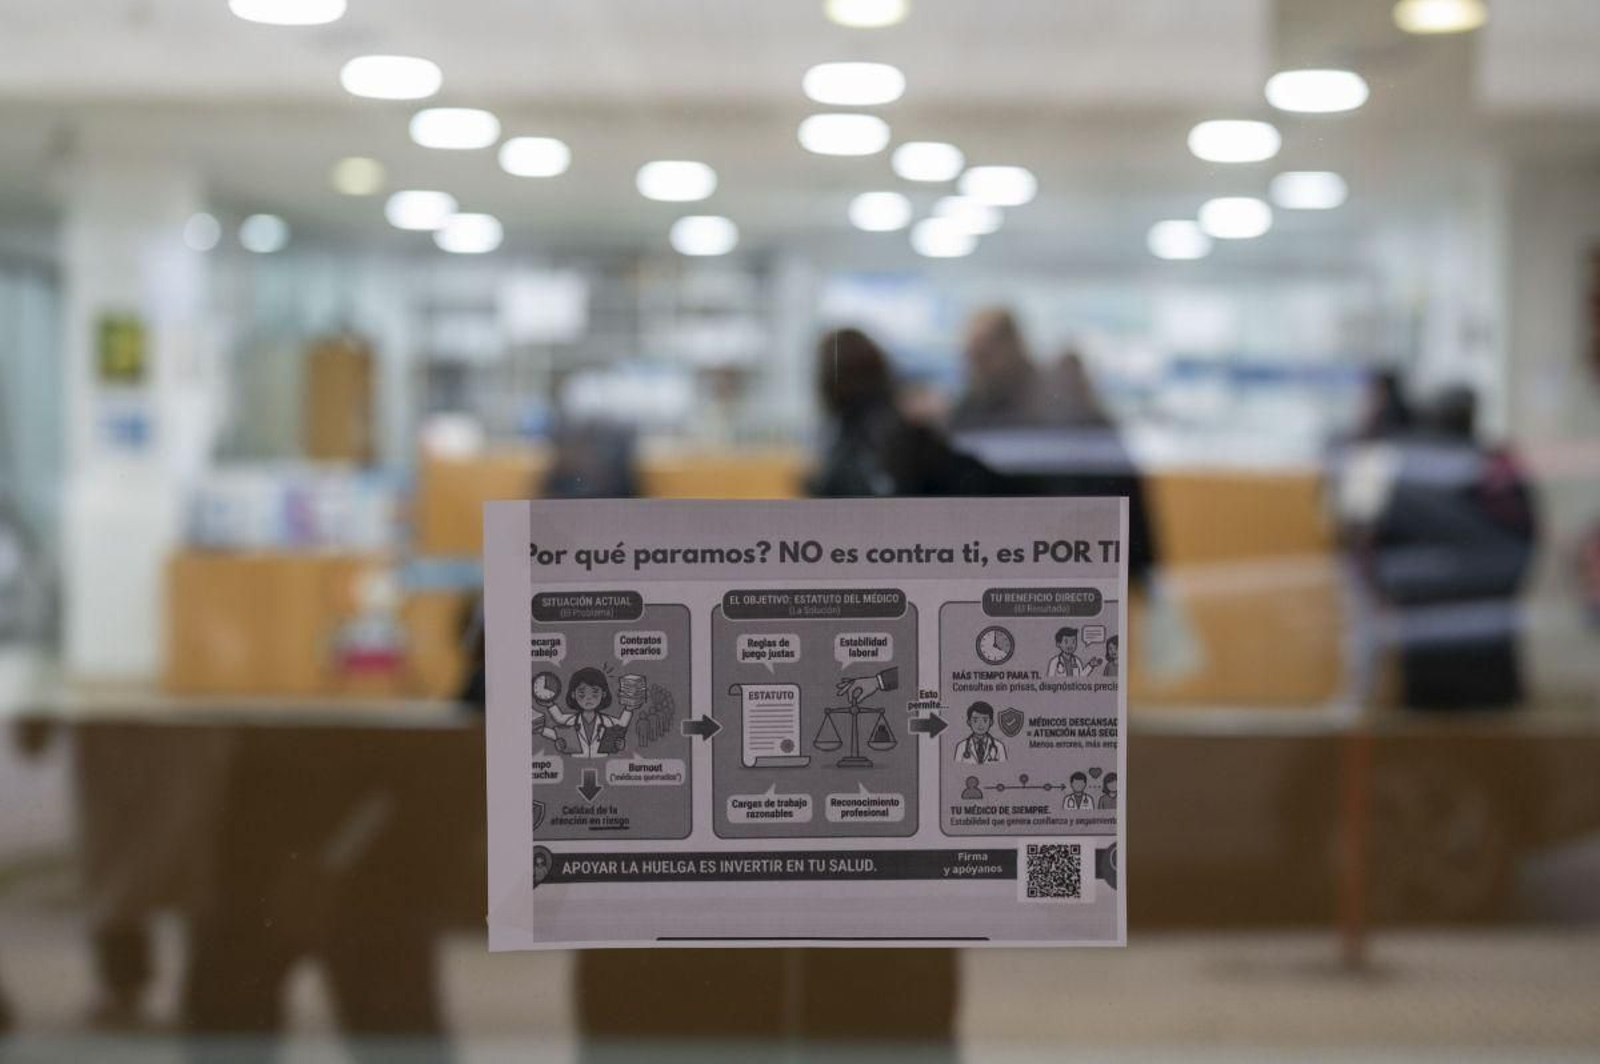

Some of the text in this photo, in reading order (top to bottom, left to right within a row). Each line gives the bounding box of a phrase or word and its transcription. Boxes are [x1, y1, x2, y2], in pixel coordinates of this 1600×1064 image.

[574, 541, 626, 571] qué
[634, 540, 772, 571] paramos?
[779, 540, 823, 563] NO
[830, 547, 858, 563] es
[866, 543, 954, 563] contra
[962, 541, 988, 567] ti,
[997, 547, 1025, 563] es
[1033, 540, 1092, 563] POR
[1098, 540, 1120, 563] TI
[541, 595, 632, 607] SITUACIÓN ACTUAL
[729, 592, 899, 605] EL OBJETIVO: ESTATUTO DEL MÉDICO
[990, 593, 1095, 603] TU BENEFICIO DIRECTO
[572, 607, 614, 618] Problema)
[789, 605, 841, 616] (La Solución)
[619, 636, 662, 645] Contratos
[747, 638, 789, 649] Reglas de
[840, 637, 887, 647] Estabilidad
[620, 646, 661, 657] precarios
[742, 649, 795, 660] juego justas
[849, 648, 878, 657] laboral
[952, 670, 1042, 680] MÁS TIEMPO PARA TI.
[952, 682, 993, 692] Consultas
[995, 682, 1008, 691] sin
[1009, 682, 1037, 693] prisas,
[1039, 681, 1092, 693] diagnósticos
[748, 691, 795, 701] ESTATUTO
[919, 690, 938, 699] Esto
[1028, 716, 1067, 727] MÉDICOS
[1033, 728, 1076, 737] ATENCIÓN
[1078, 727, 1097, 737] MÁS
[1028, 740, 1053, 748] Menos
[1085, 740, 1100, 748] más
[628, 763, 663, 772] Burnout
[731, 798, 807, 809] Cargas de trabajo
[830, 798, 900, 807] Reconocimiento
[562, 805, 618, 815] Calidad de la
[746, 808, 793, 818] razonables
[840, 808, 889, 818] profesional
[950, 804, 1052, 815] TU MÉDICO DE SIEMPRE.
[551, 815, 630, 827] atención en riesgo
[950, 816, 989, 826] Estabilidad
[991, 817, 1006, 827] que
[1032, 816, 1068, 826] confianza
[957, 852, 988, 862] Firma
[562, 858, 877, 875] APOYAR LA HUELGA ES INVERTIR EN TU SALUD.
[943, 863, 1003, 876] y apóyanos
